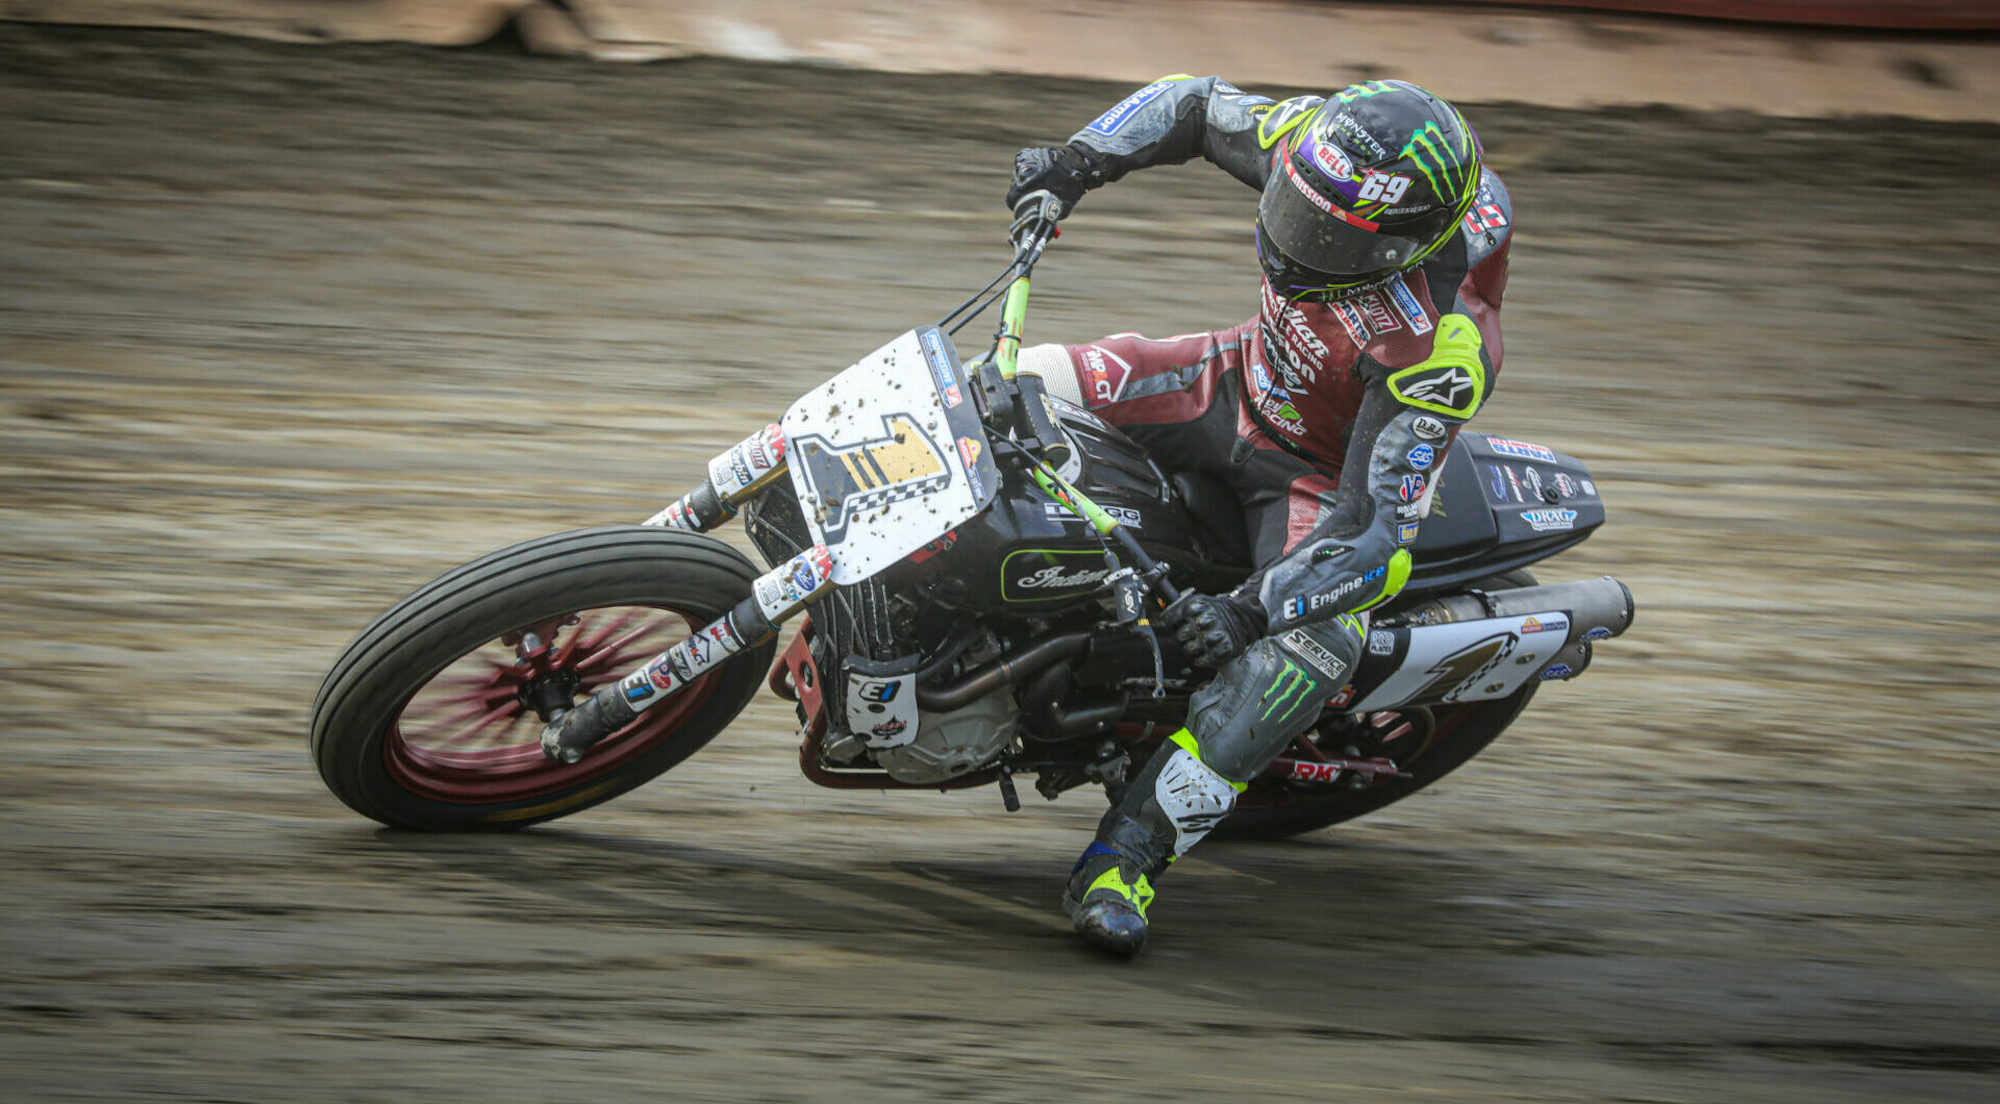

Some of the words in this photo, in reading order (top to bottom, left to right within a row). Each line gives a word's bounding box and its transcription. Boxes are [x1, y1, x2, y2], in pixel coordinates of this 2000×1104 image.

[1316, 145, 1349, 177] BELL
[1358, 172, 1411, 203] 69
[1341, 300, 1369, 342] ARTS
[1291, 332, 1323, 370] RACING
[792, 412, 951, 545] 1
[1403, 474, 1423, 500] VP
[1530, 509, 1571, 522] DRAG
[813, 544, 833, 580] RK
[1017, 567, 1109, 589] Indian
[1290, 629, 1348, 672] SERVICE
[1297, 762, 1337, 782] RK
